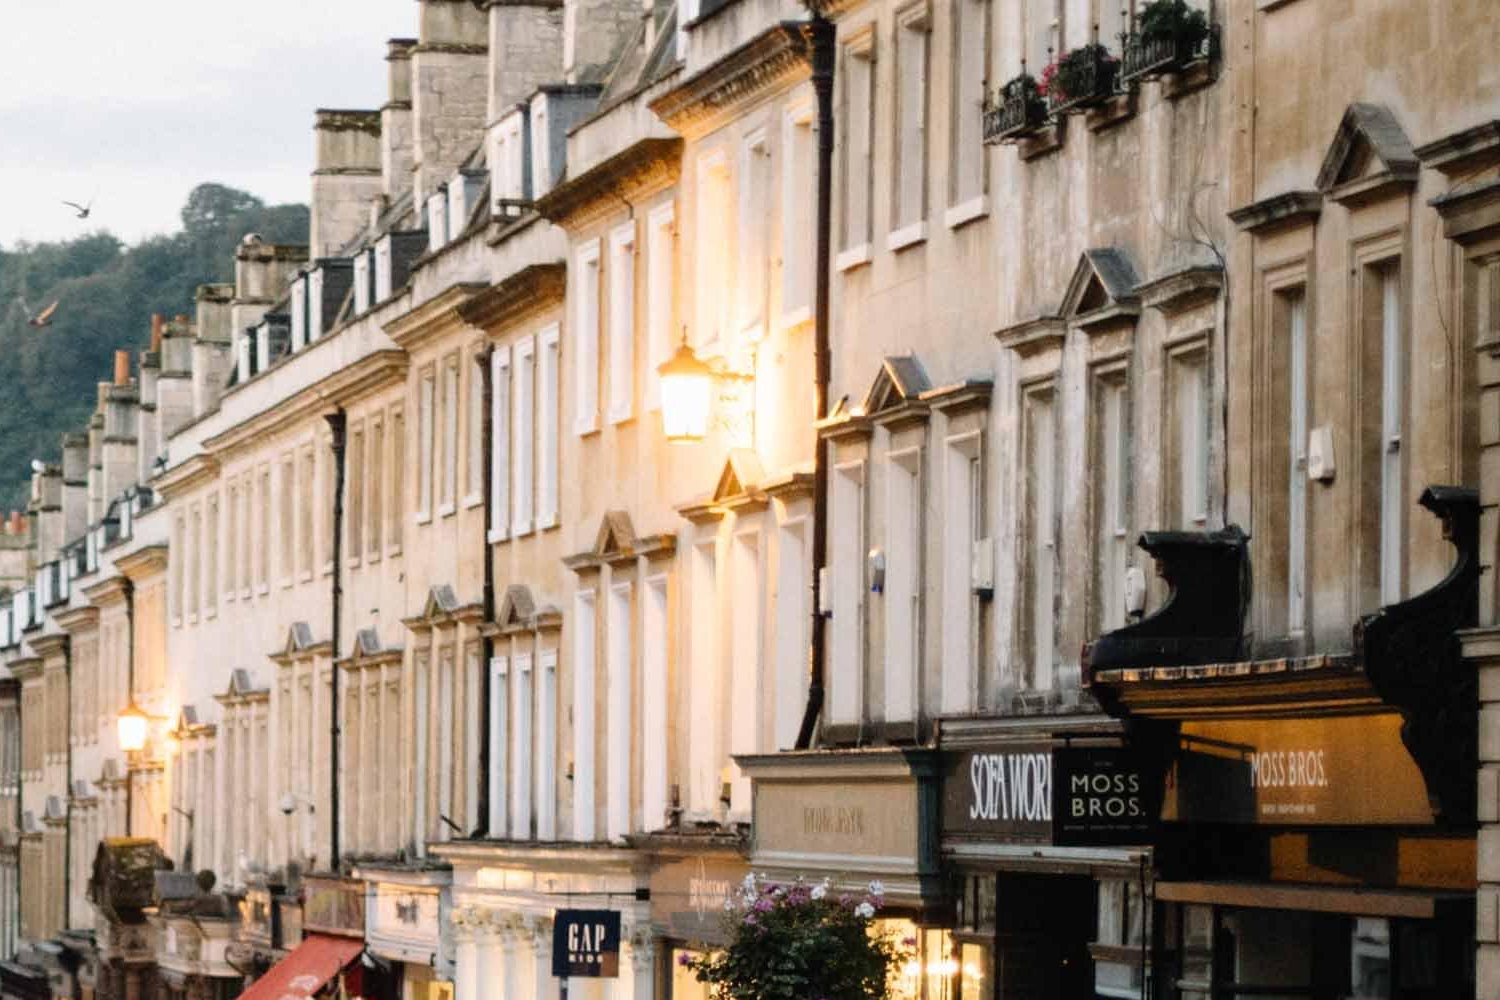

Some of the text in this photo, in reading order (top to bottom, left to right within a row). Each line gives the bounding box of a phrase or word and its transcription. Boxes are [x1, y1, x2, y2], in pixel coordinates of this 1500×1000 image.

[1251, 749, 1328, 787] MOSS BROS.
[970, 754, 1008, 820] SOFA
[1071, 774, 1140, 793] MOSS
[1071, 797, 1147, 817] BROS.
[568, 923, 606, 952] GAP
